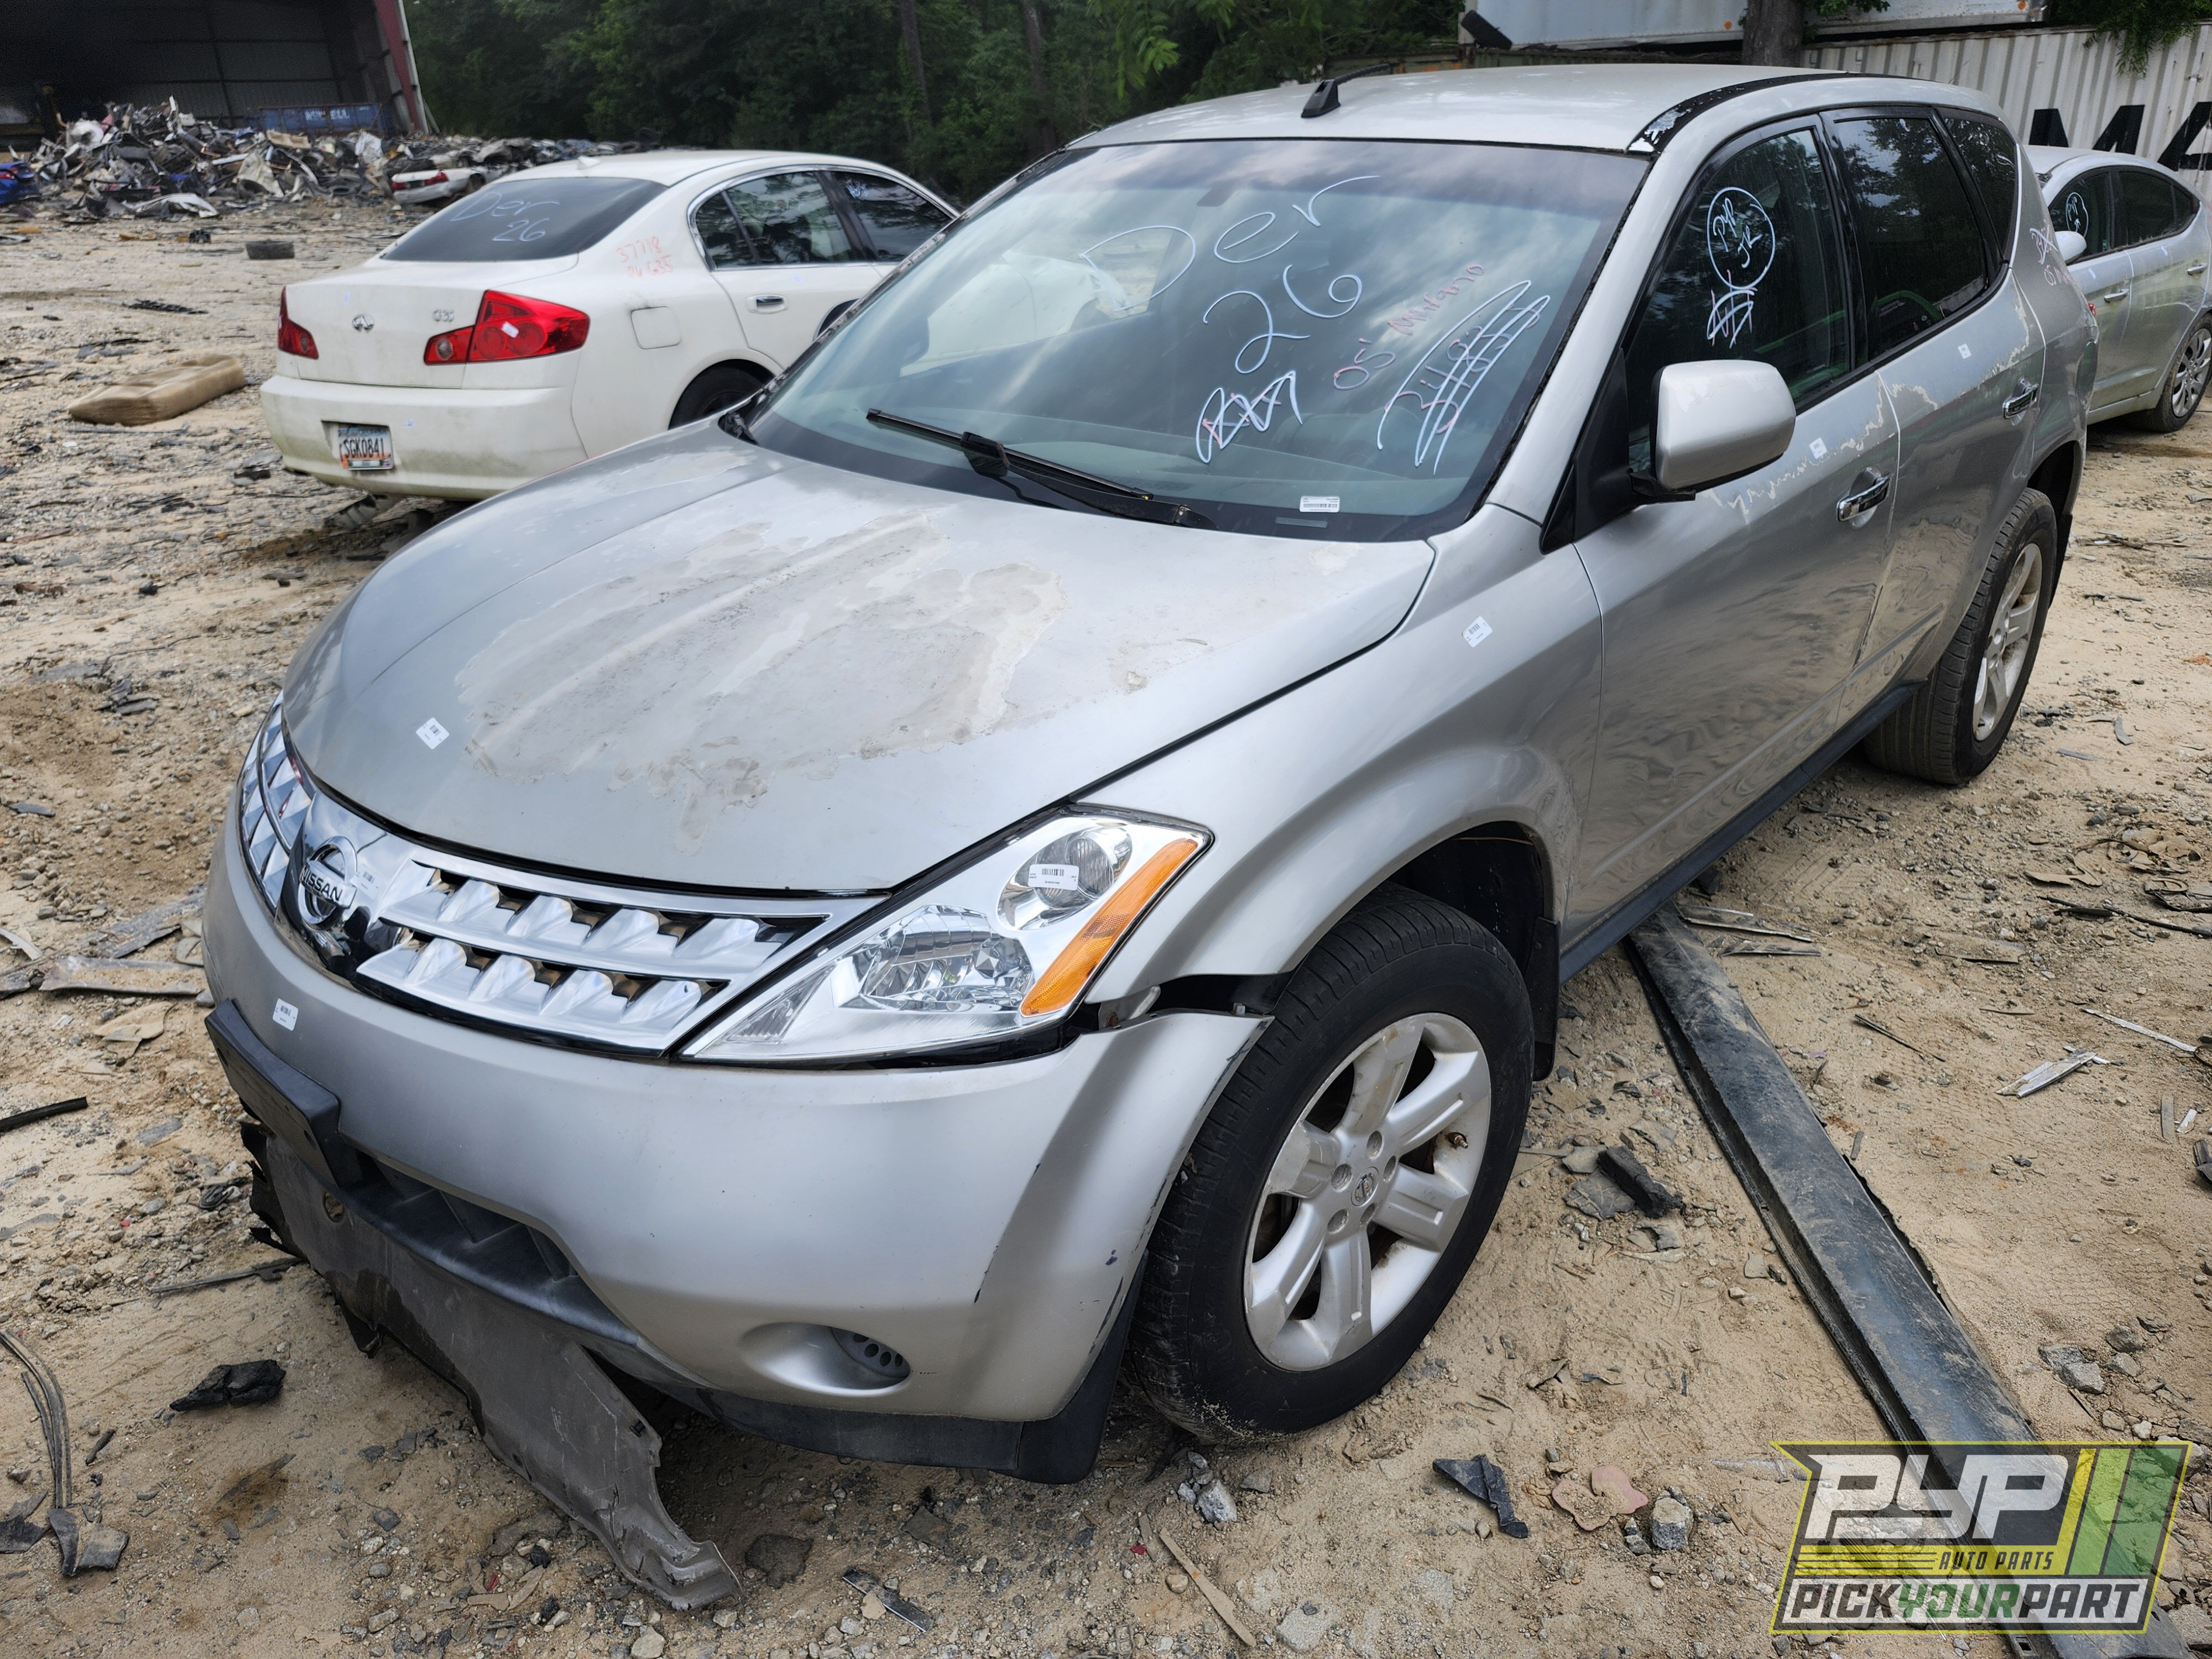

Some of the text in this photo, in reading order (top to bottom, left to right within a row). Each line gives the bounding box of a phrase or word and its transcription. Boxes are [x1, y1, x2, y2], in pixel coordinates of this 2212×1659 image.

[450, 192, 560, 221] Der
[492, 217, 549, 242] 26
[1078, 175, 1381, 312] Der
[616, 236, 662, 263] 37718
[1203, 264, 1363, 374] 26
[299, 865, 343, 901] NISSAN
